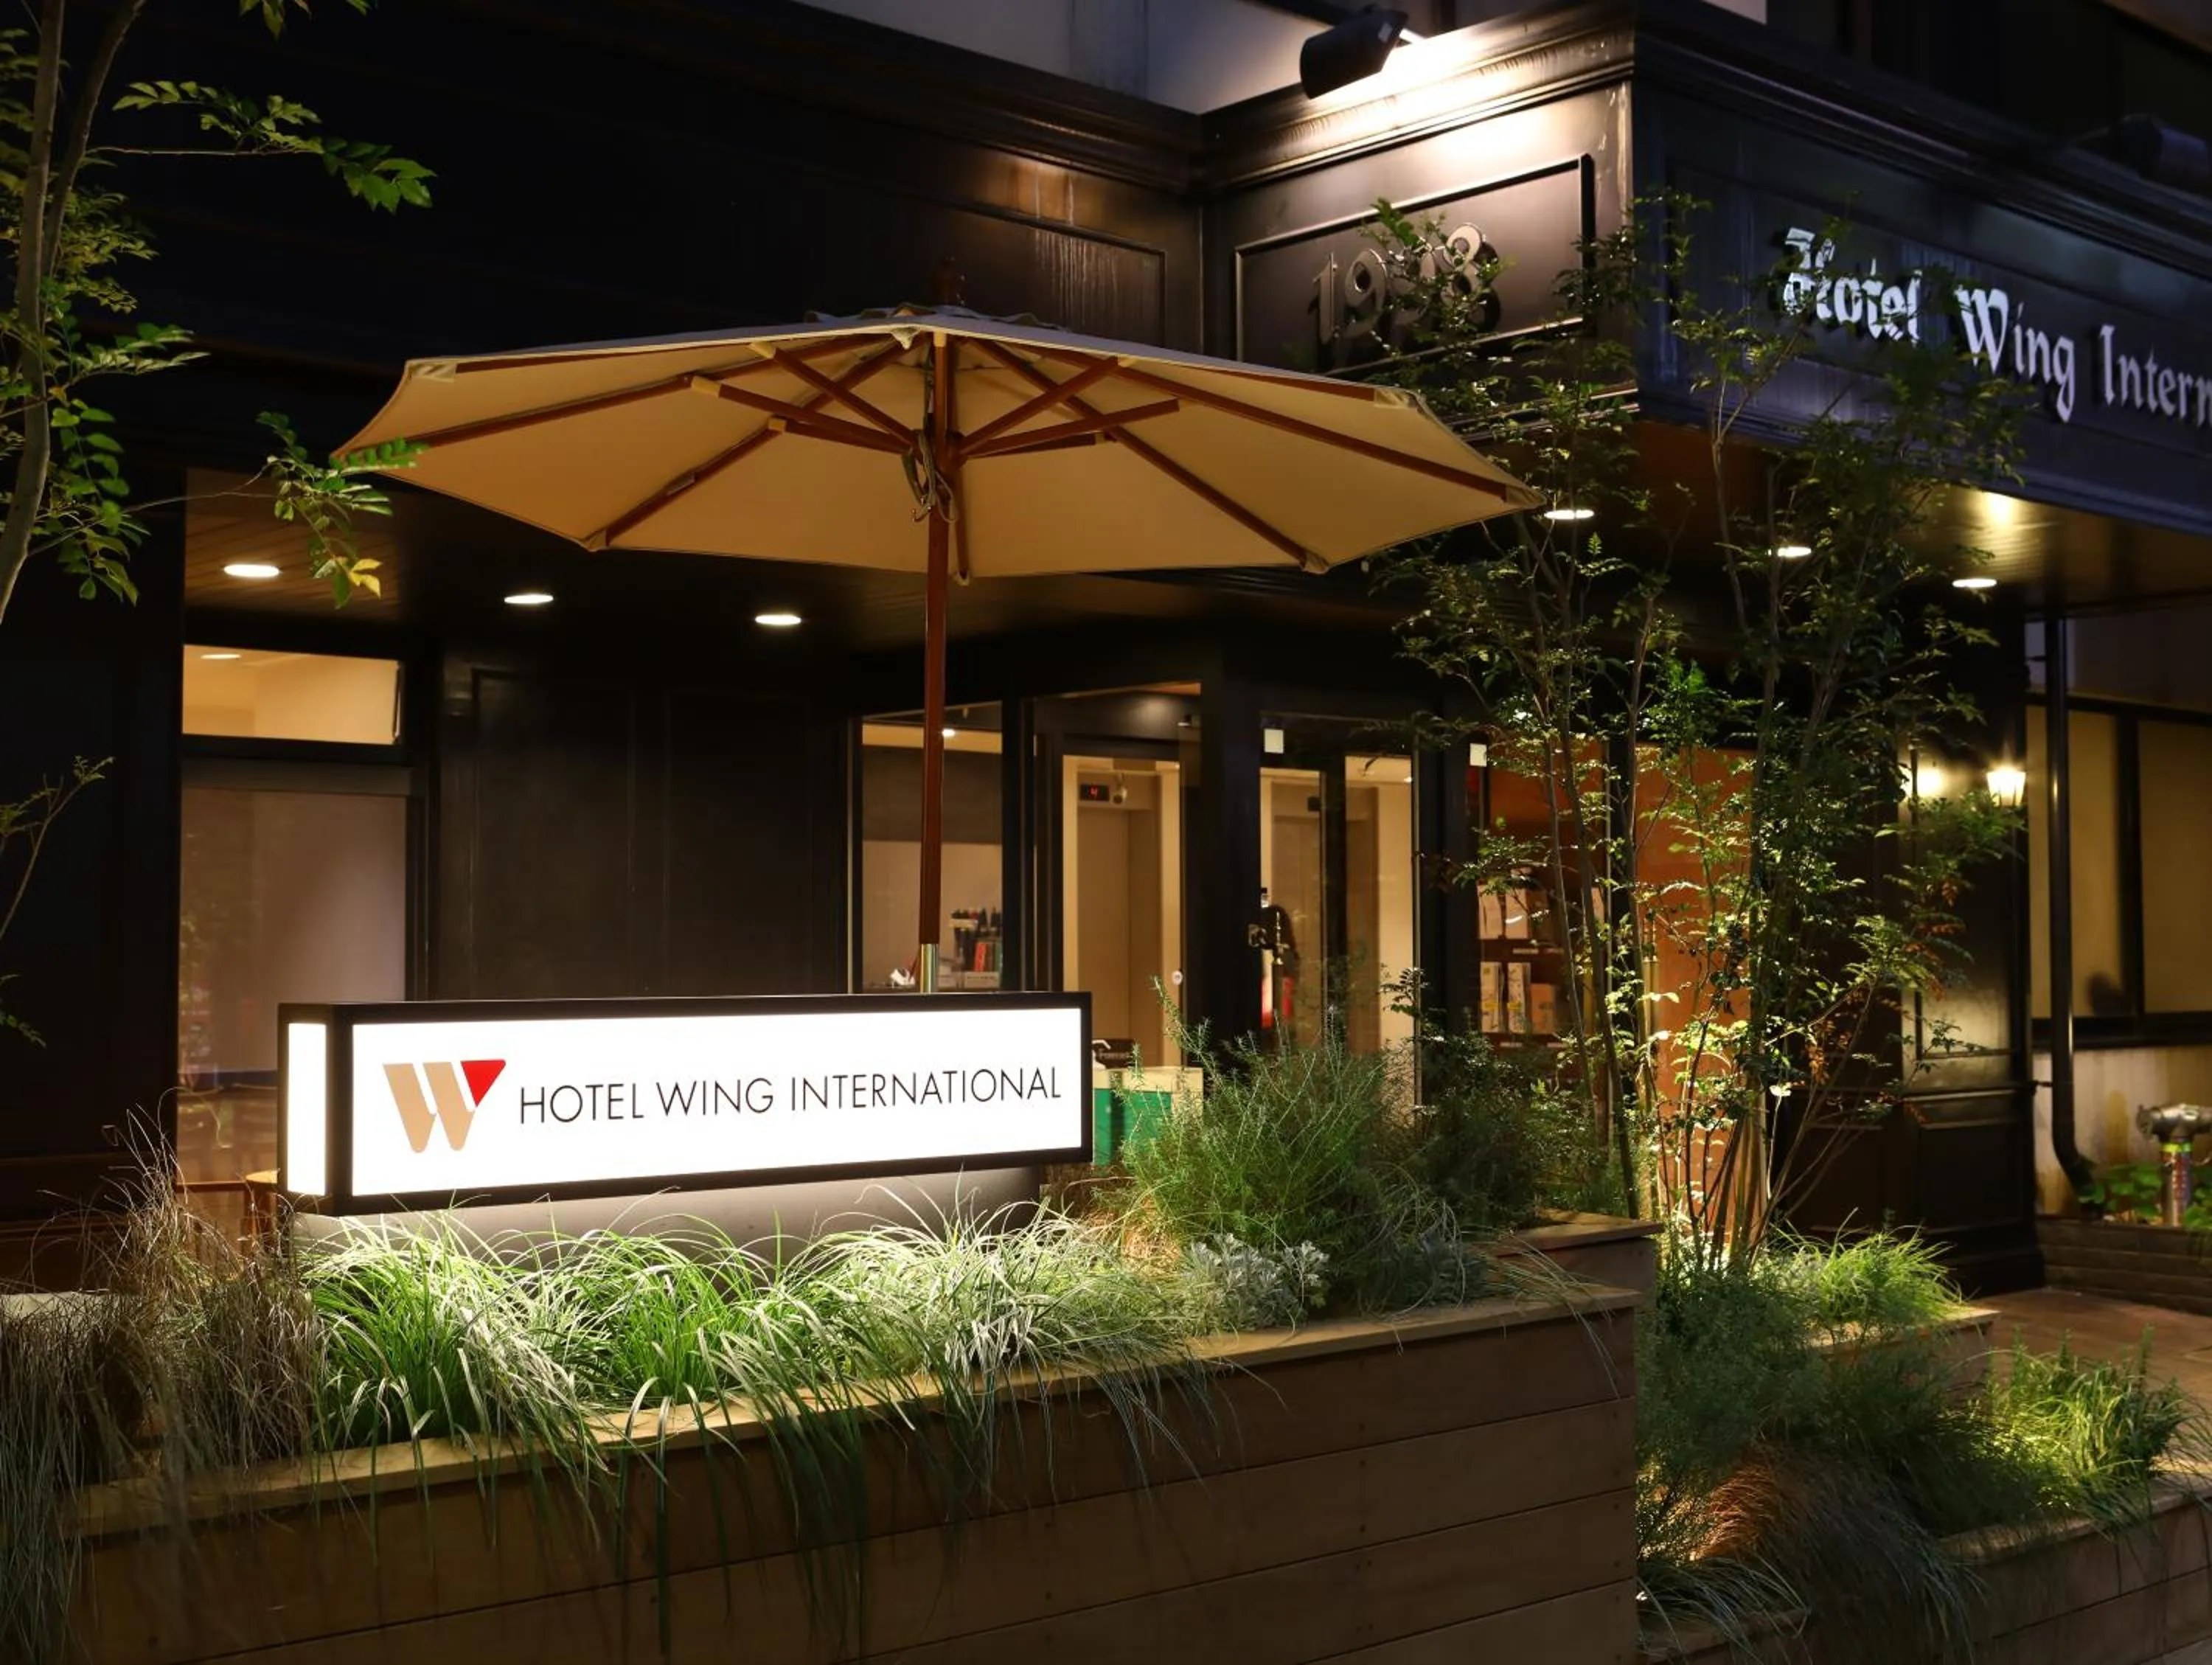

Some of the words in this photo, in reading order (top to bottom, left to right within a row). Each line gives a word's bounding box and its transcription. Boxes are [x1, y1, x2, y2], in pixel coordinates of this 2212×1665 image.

[1783, 227, 1923, 348] Hotel
[1954, 285, 2074, 423] Wing
[2099, 323, 2212, 428] Intern
[520, 1082, 644, 1125] HOTEL
[655, 1077, 774, 1117] WING
[790, 1066, 1062, 1112] INTERNATIONAL
